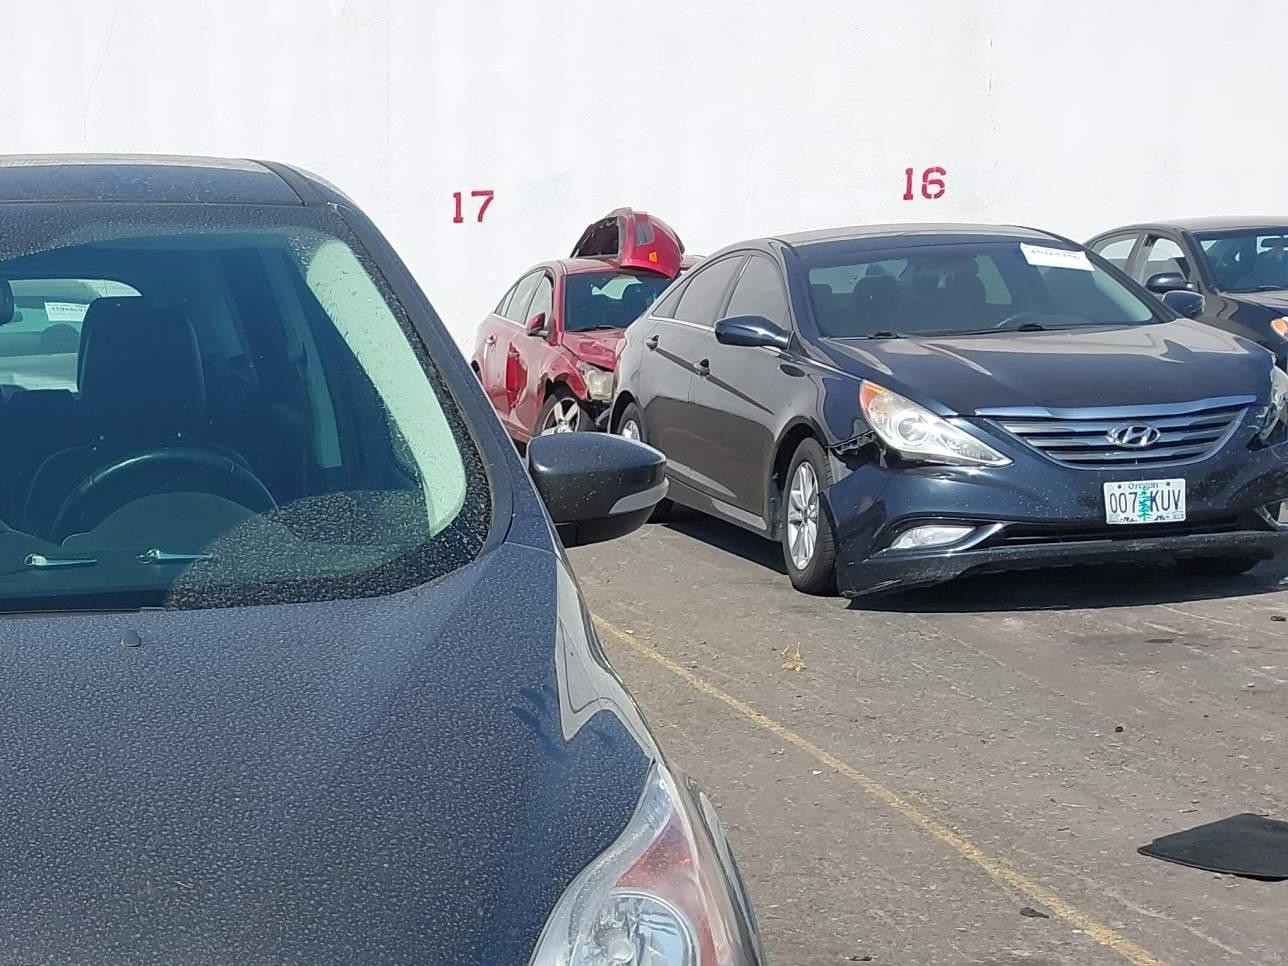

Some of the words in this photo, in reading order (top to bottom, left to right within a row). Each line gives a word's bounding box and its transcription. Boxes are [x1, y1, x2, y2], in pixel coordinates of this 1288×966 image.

[903, 166, 947, 201] 16
[453, 190, 495, 224] 17
[1109, 491, 1138, 514] 007
[1150, 488, 1182, 513] KUV
[1127, 482, 1159, 491] Oregon
